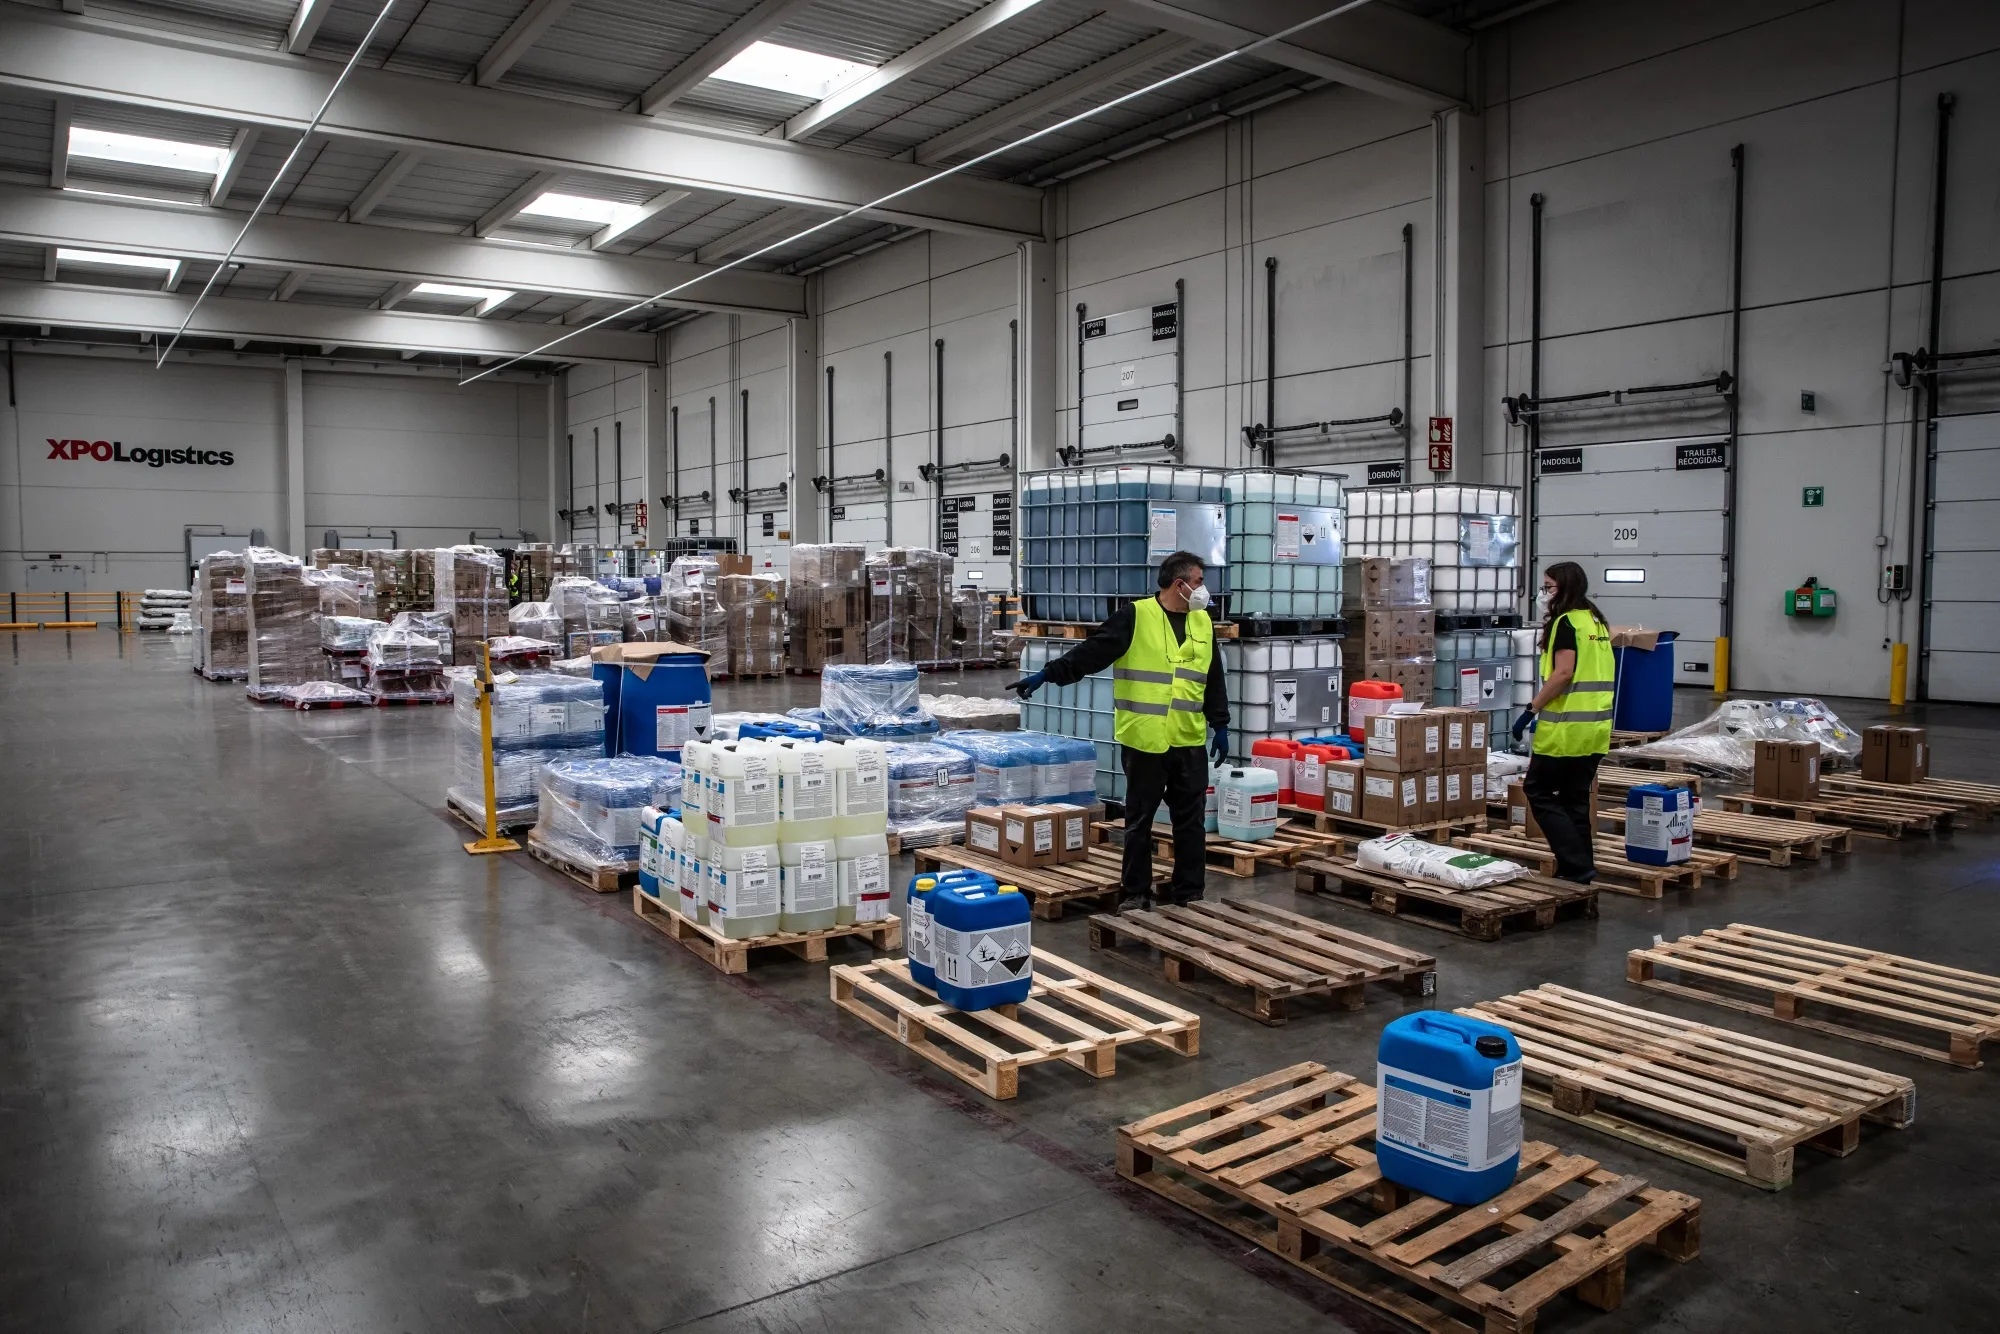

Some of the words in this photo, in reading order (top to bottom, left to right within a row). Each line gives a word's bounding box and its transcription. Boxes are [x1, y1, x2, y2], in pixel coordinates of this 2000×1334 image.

[1152, 309, 1176, 318] ZARAGOZA
[1086, 320, 1104, 329] OPORTO
[1152, 325, 1176, 336] HUESCA
[1122, 371, 1134, 380] 207
[1684, 448, 1717, 458] TRAILER
[1541, 456, 1582, 466] ANDOSILLA
[1678, 455, 1723, 466] RECOGIDAS
[1368, 470, 1401, 480] LOGROÑO
[943, 531, 957, 540] GUIA
[1613, 528, 1638, 541] 209
